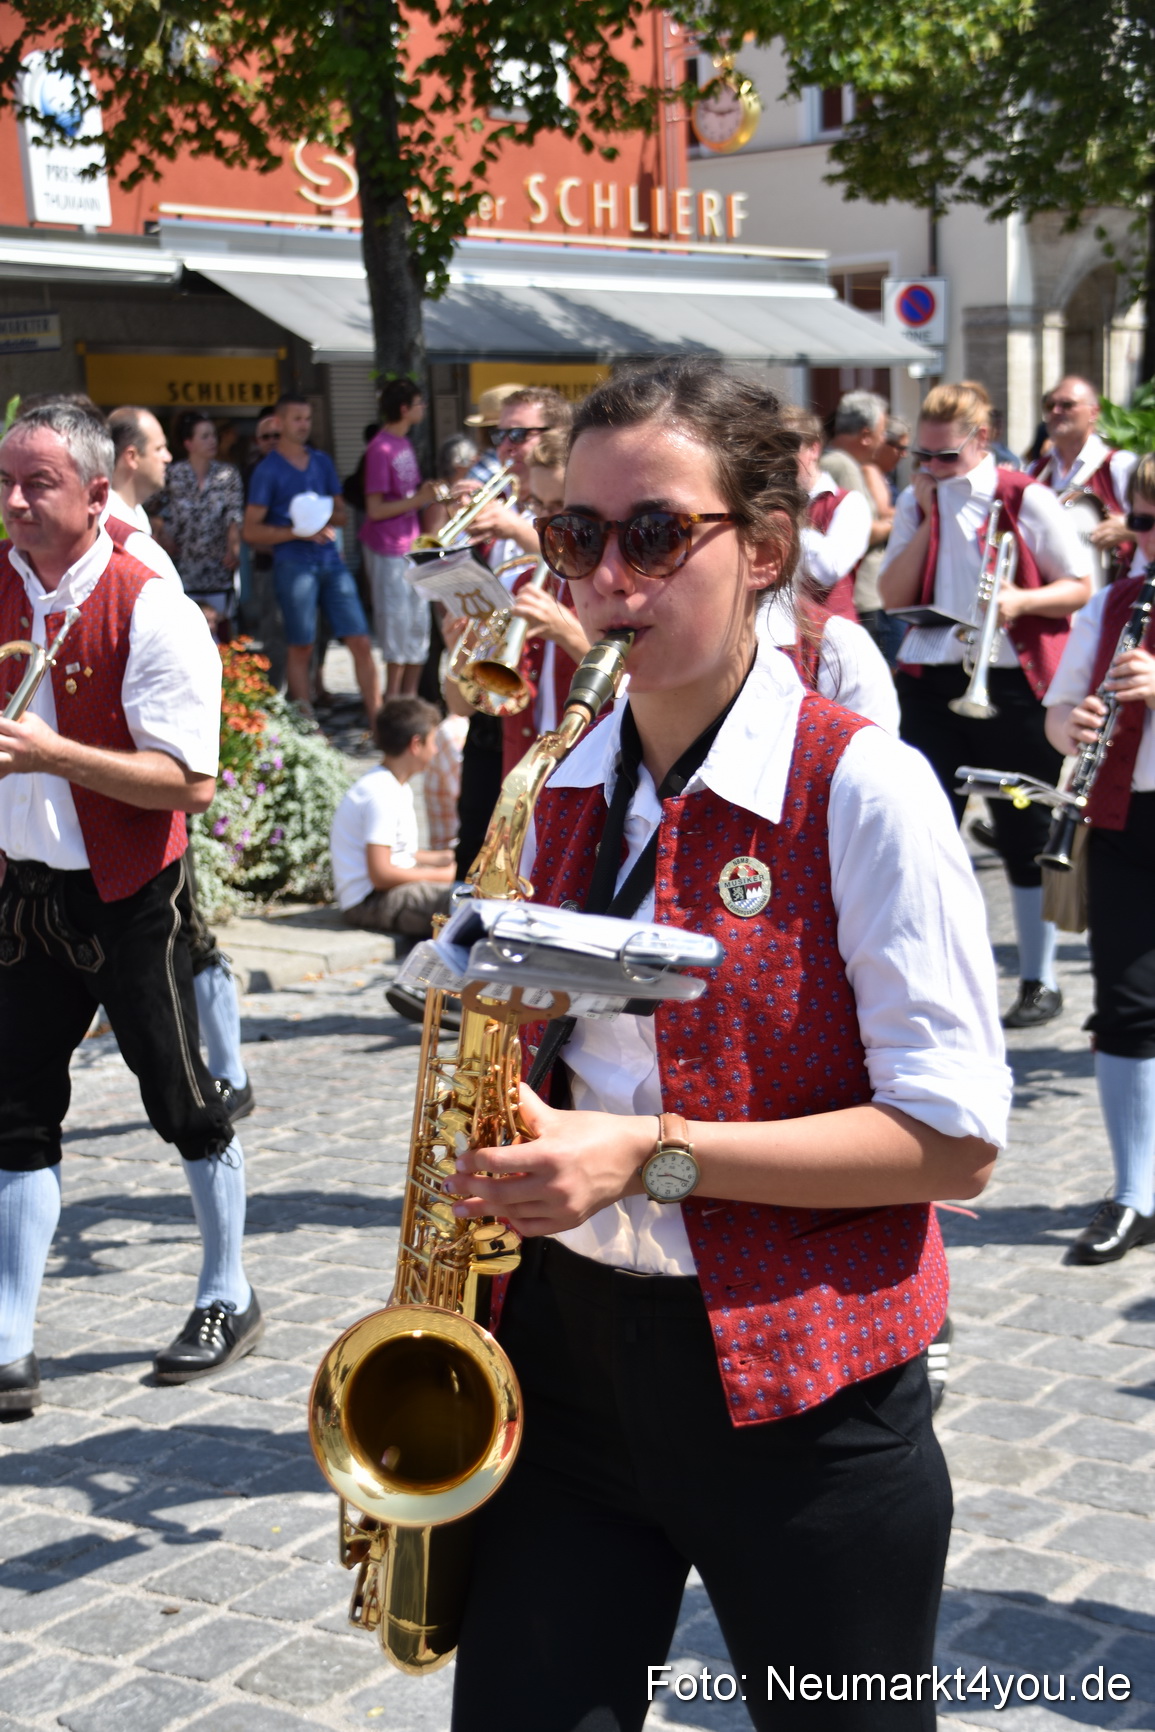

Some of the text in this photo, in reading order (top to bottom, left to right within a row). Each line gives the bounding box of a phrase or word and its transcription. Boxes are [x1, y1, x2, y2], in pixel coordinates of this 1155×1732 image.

[524, 173, 748, 238] SCHLIERF
[167, 381, 278, 403] SCHLIERF
[724, 874, 764, 888] MUSIKER
